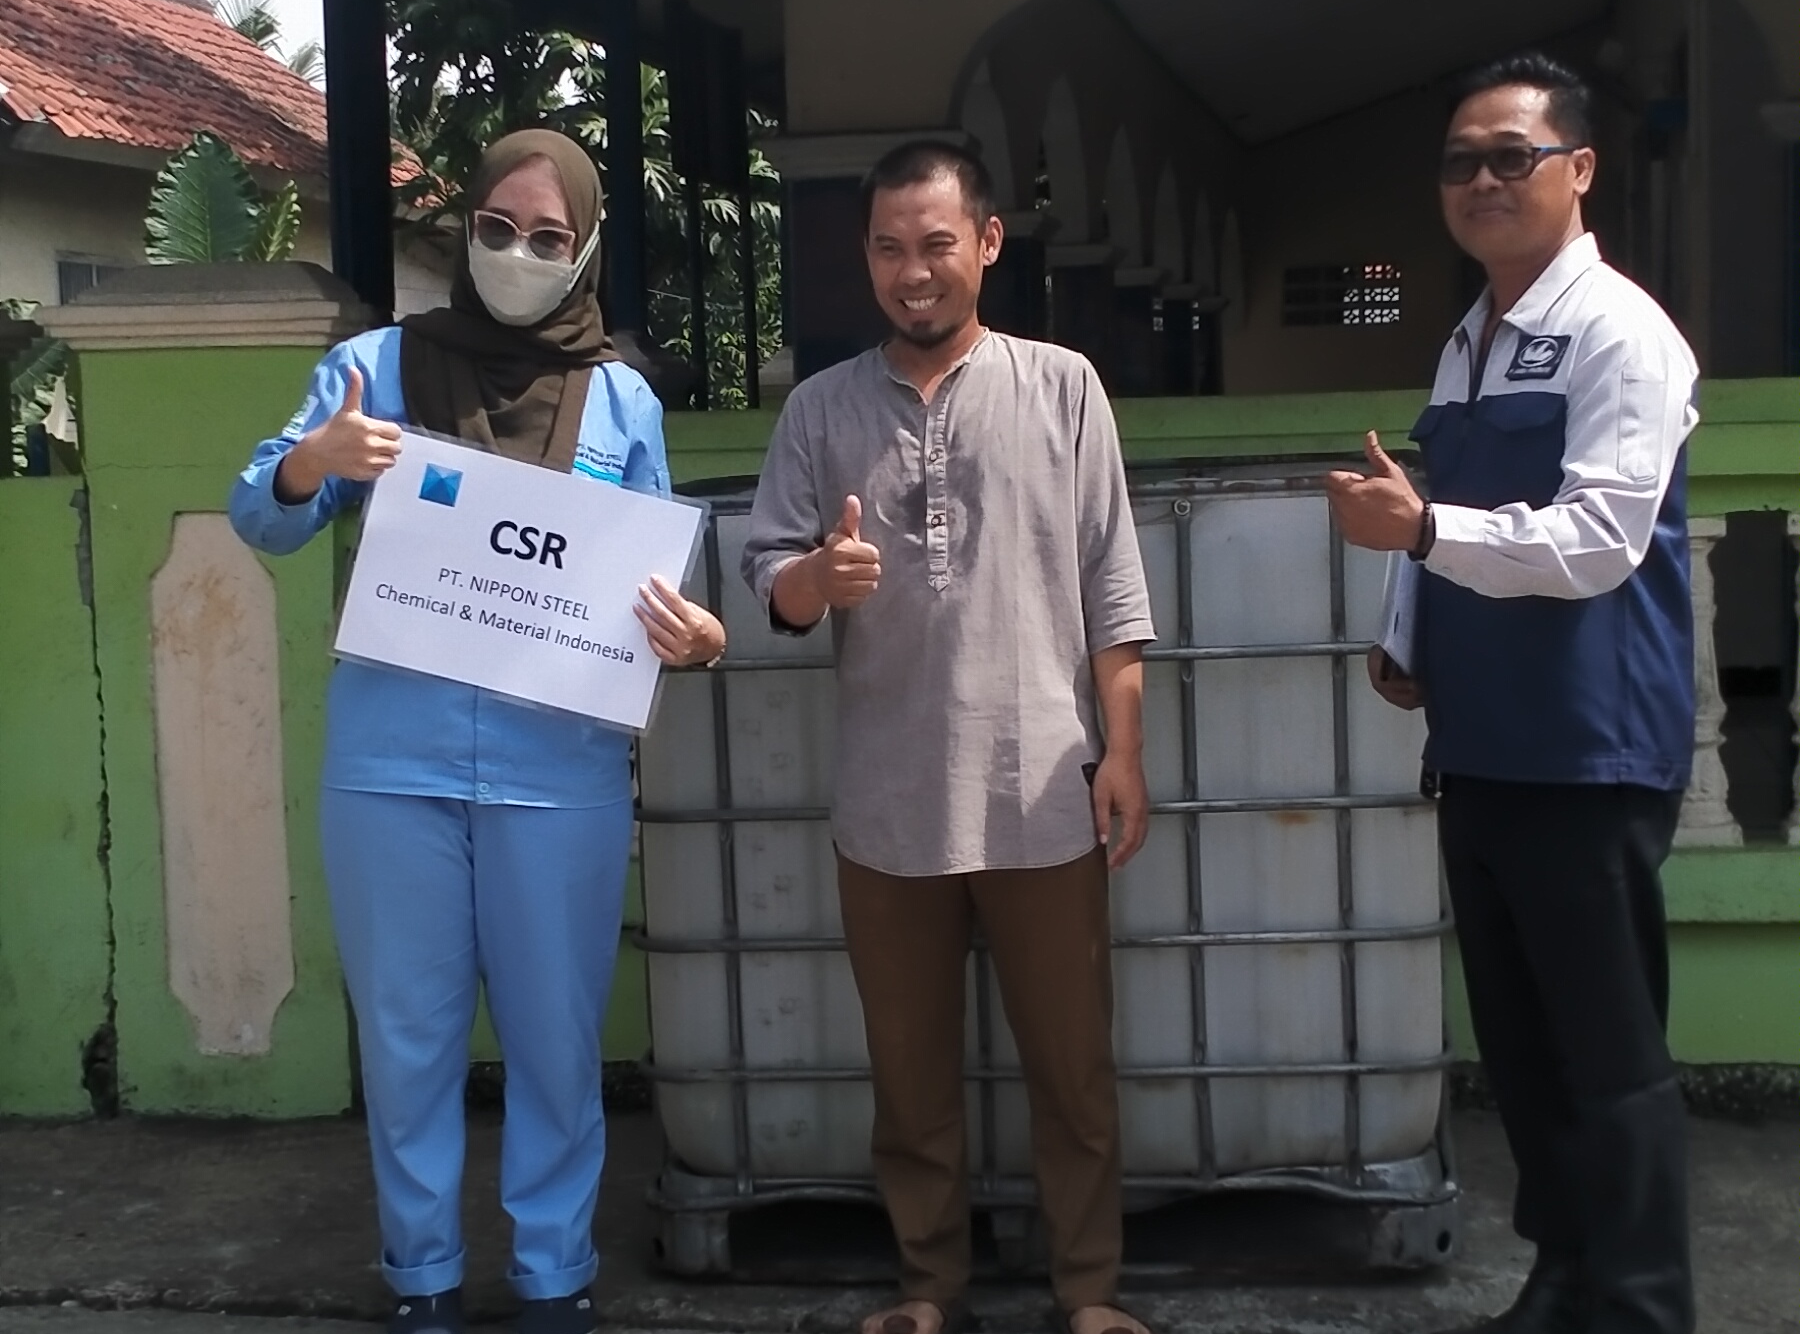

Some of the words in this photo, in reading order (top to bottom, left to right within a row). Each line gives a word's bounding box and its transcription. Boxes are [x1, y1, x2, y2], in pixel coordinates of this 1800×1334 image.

[490, 520, 568, 570] CSR
[438, 567, 464, 588] PT.
[469, 575, 539, 607] NIPPON
[541, 595, 590, 621] STEEL
[375, 583, 456, 617] Chemical
[459, 604, 473, 622] &
[478, 609, 552, 642] Material
[554, 629, 635, 665] Indonesia
